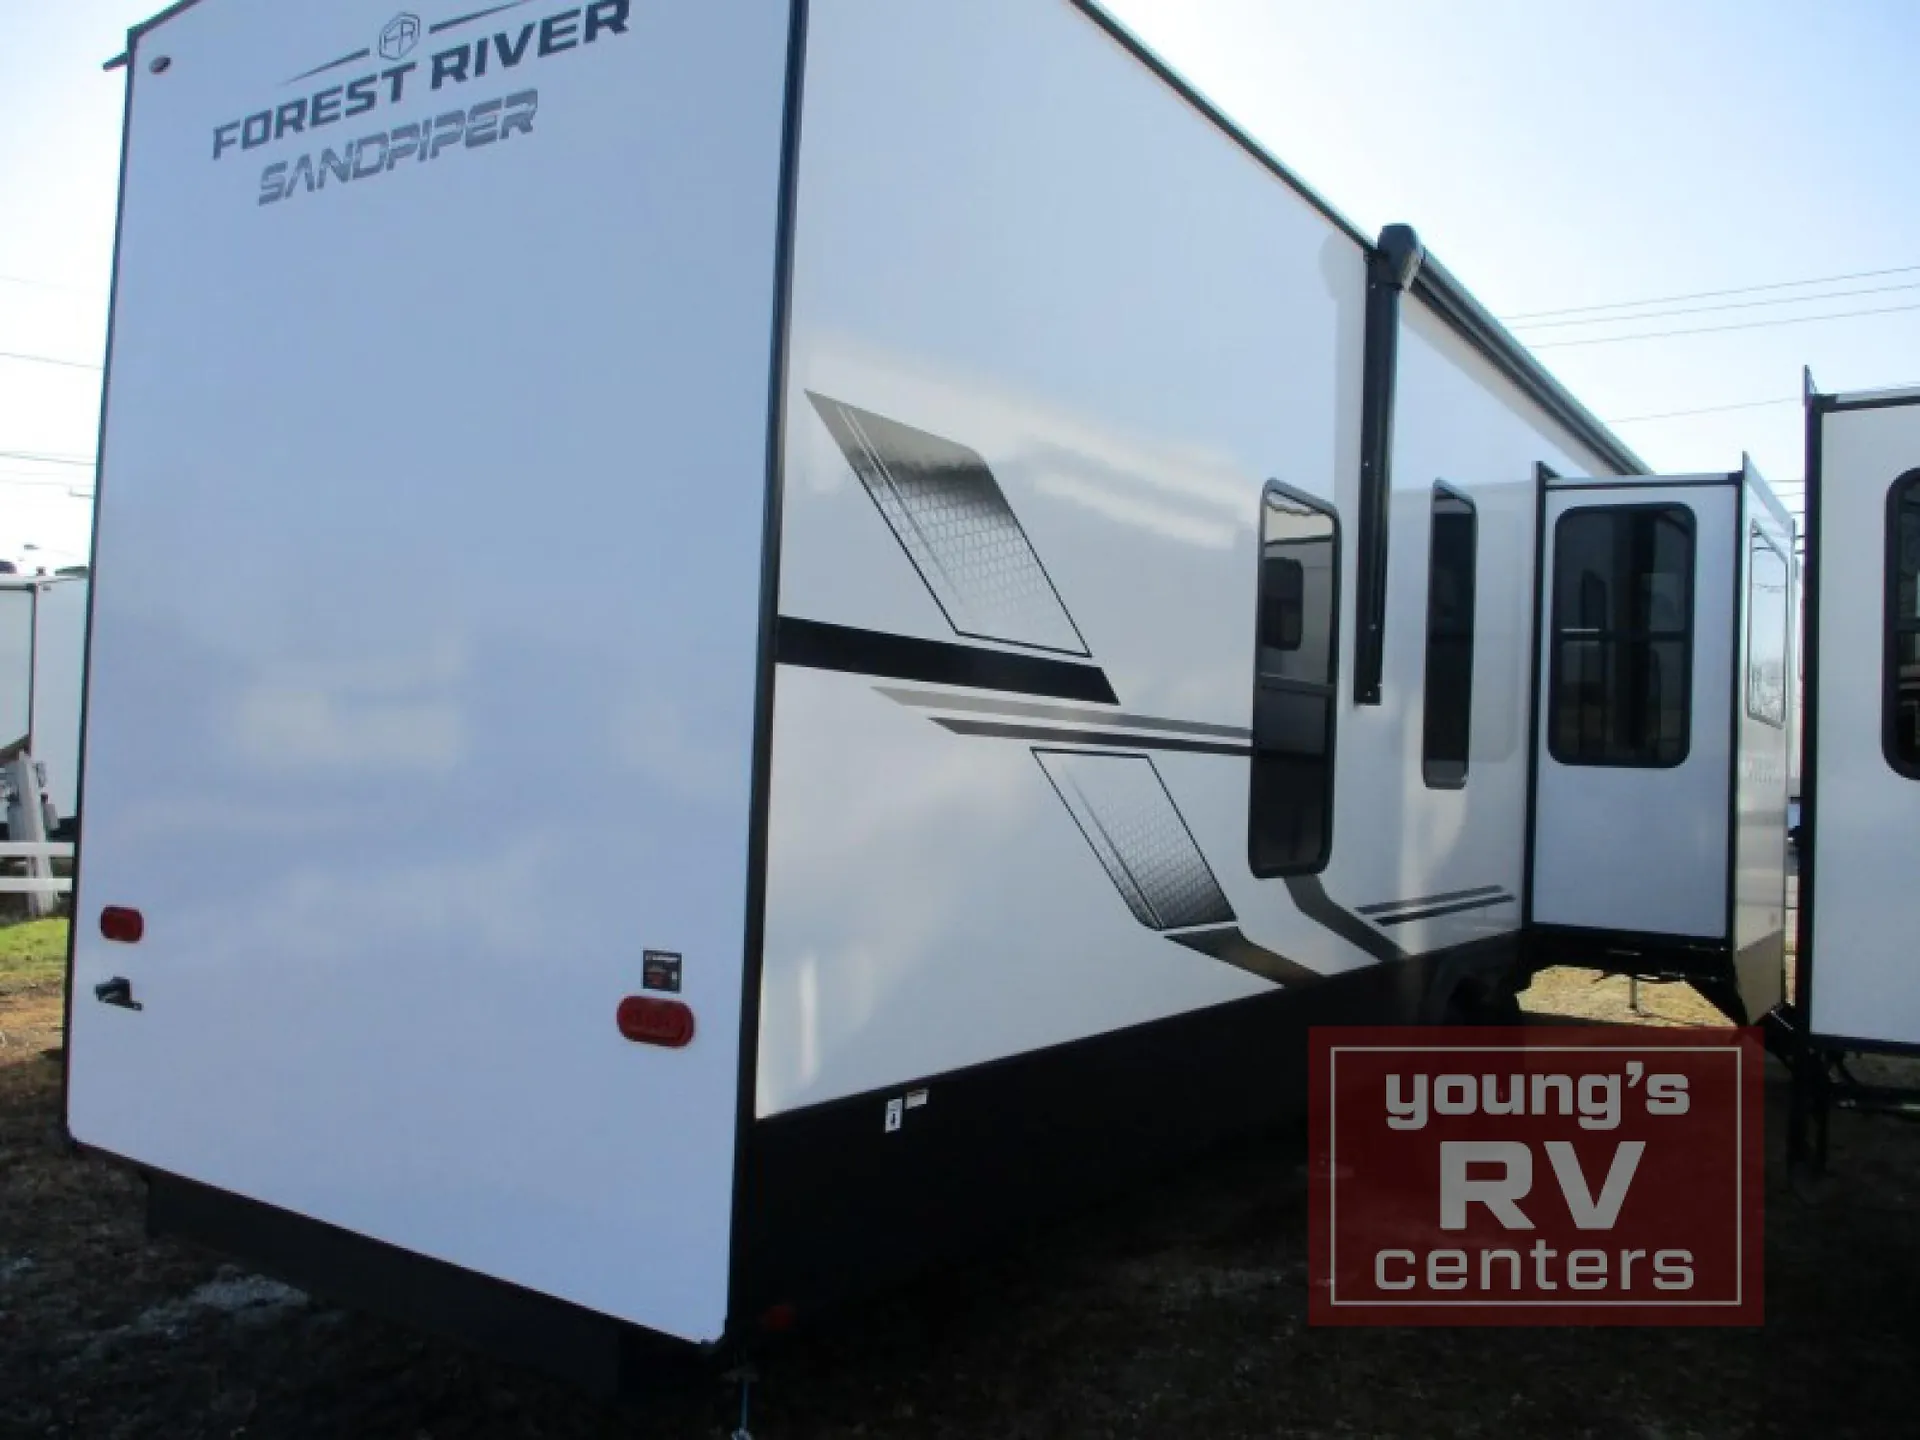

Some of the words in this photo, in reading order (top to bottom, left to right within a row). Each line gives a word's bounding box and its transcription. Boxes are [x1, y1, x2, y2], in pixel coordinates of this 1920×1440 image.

[212, 61, 417, 160] FOREST
[430, 0, 631, 90] RIVER
[257, 88, 539, 206] SANDPIPER
